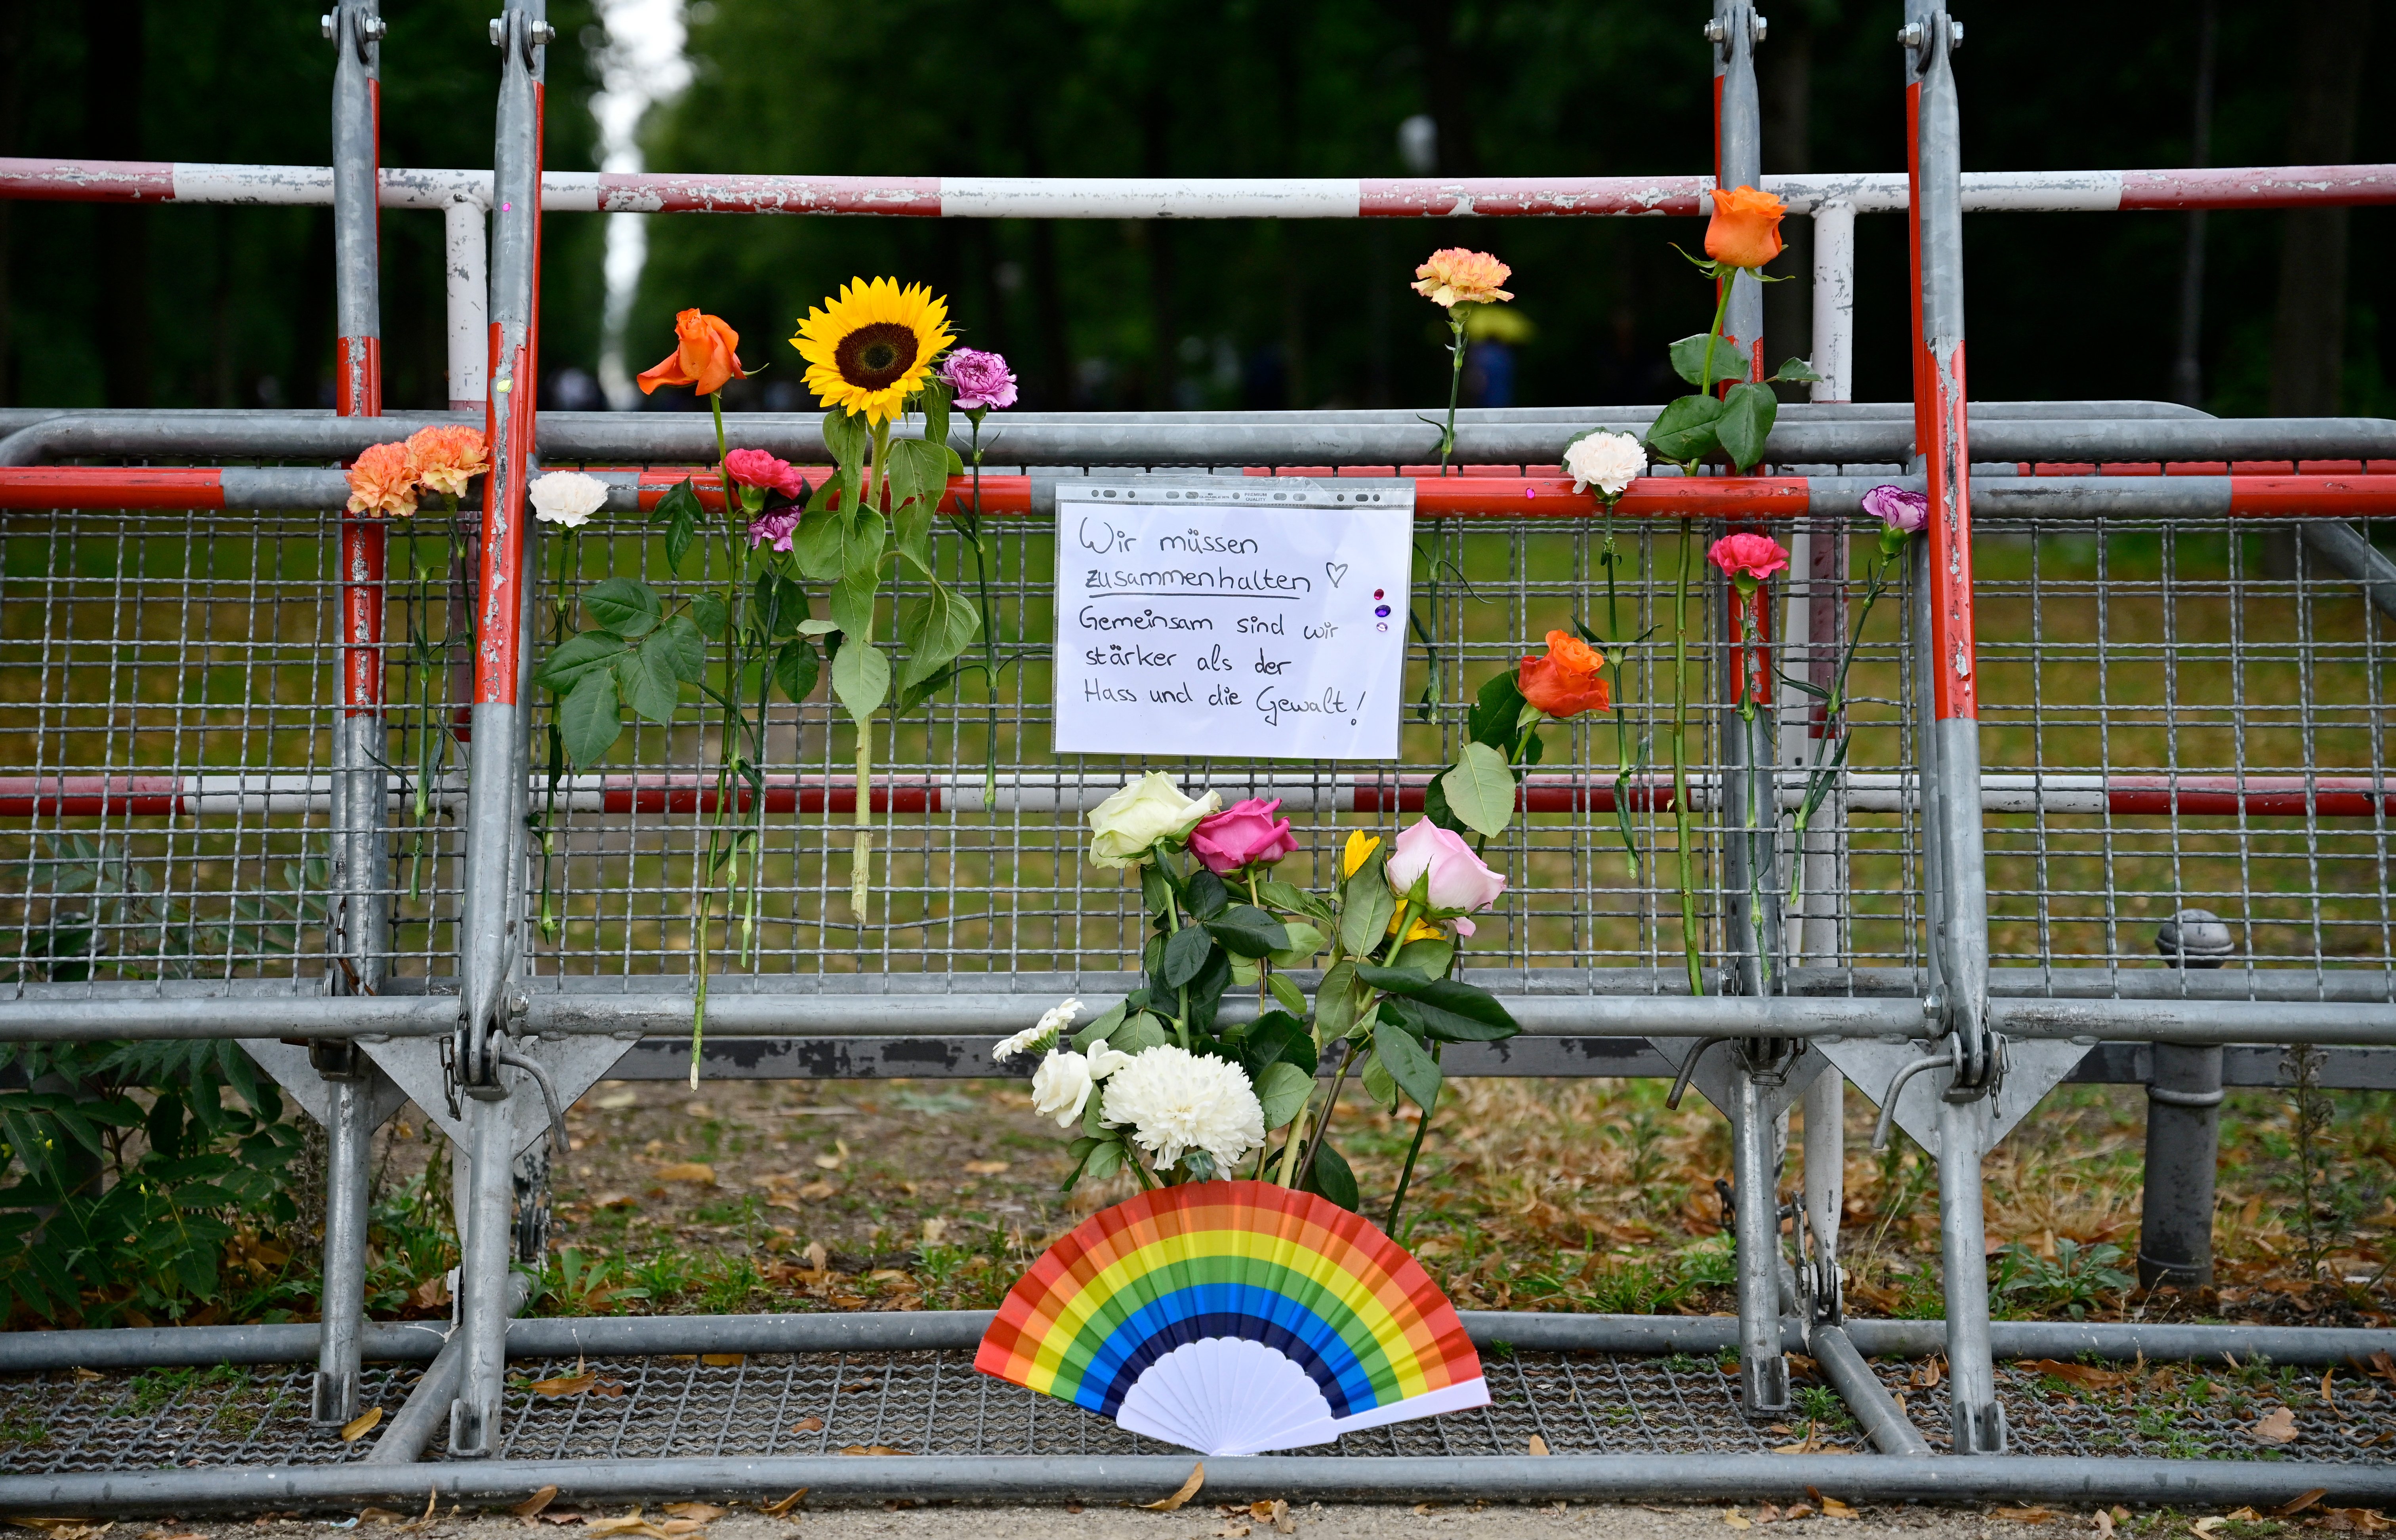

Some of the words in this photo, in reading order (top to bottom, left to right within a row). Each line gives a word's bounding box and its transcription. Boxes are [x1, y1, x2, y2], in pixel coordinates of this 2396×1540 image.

[1079, 517, 1137, 554] Wir
[1160, 528, 1258, 554] müssen
[1085, 566, 1311, 593] zusammenhalten
[1079, 605, 1213, 631] Gemeinsam
[1236, 613, 1285, 636] sind
[1304, 622, 1339, 640] wir
[1085, 644, 1177, 667] stärker
[1197, 644, 1233, 672] als
[1255, 647, 1292, 676] der
[1084, 678, 1138, 702] Hass
[1150, 681, 1194, 704] und
[1208, 683, 1243, 706] die
